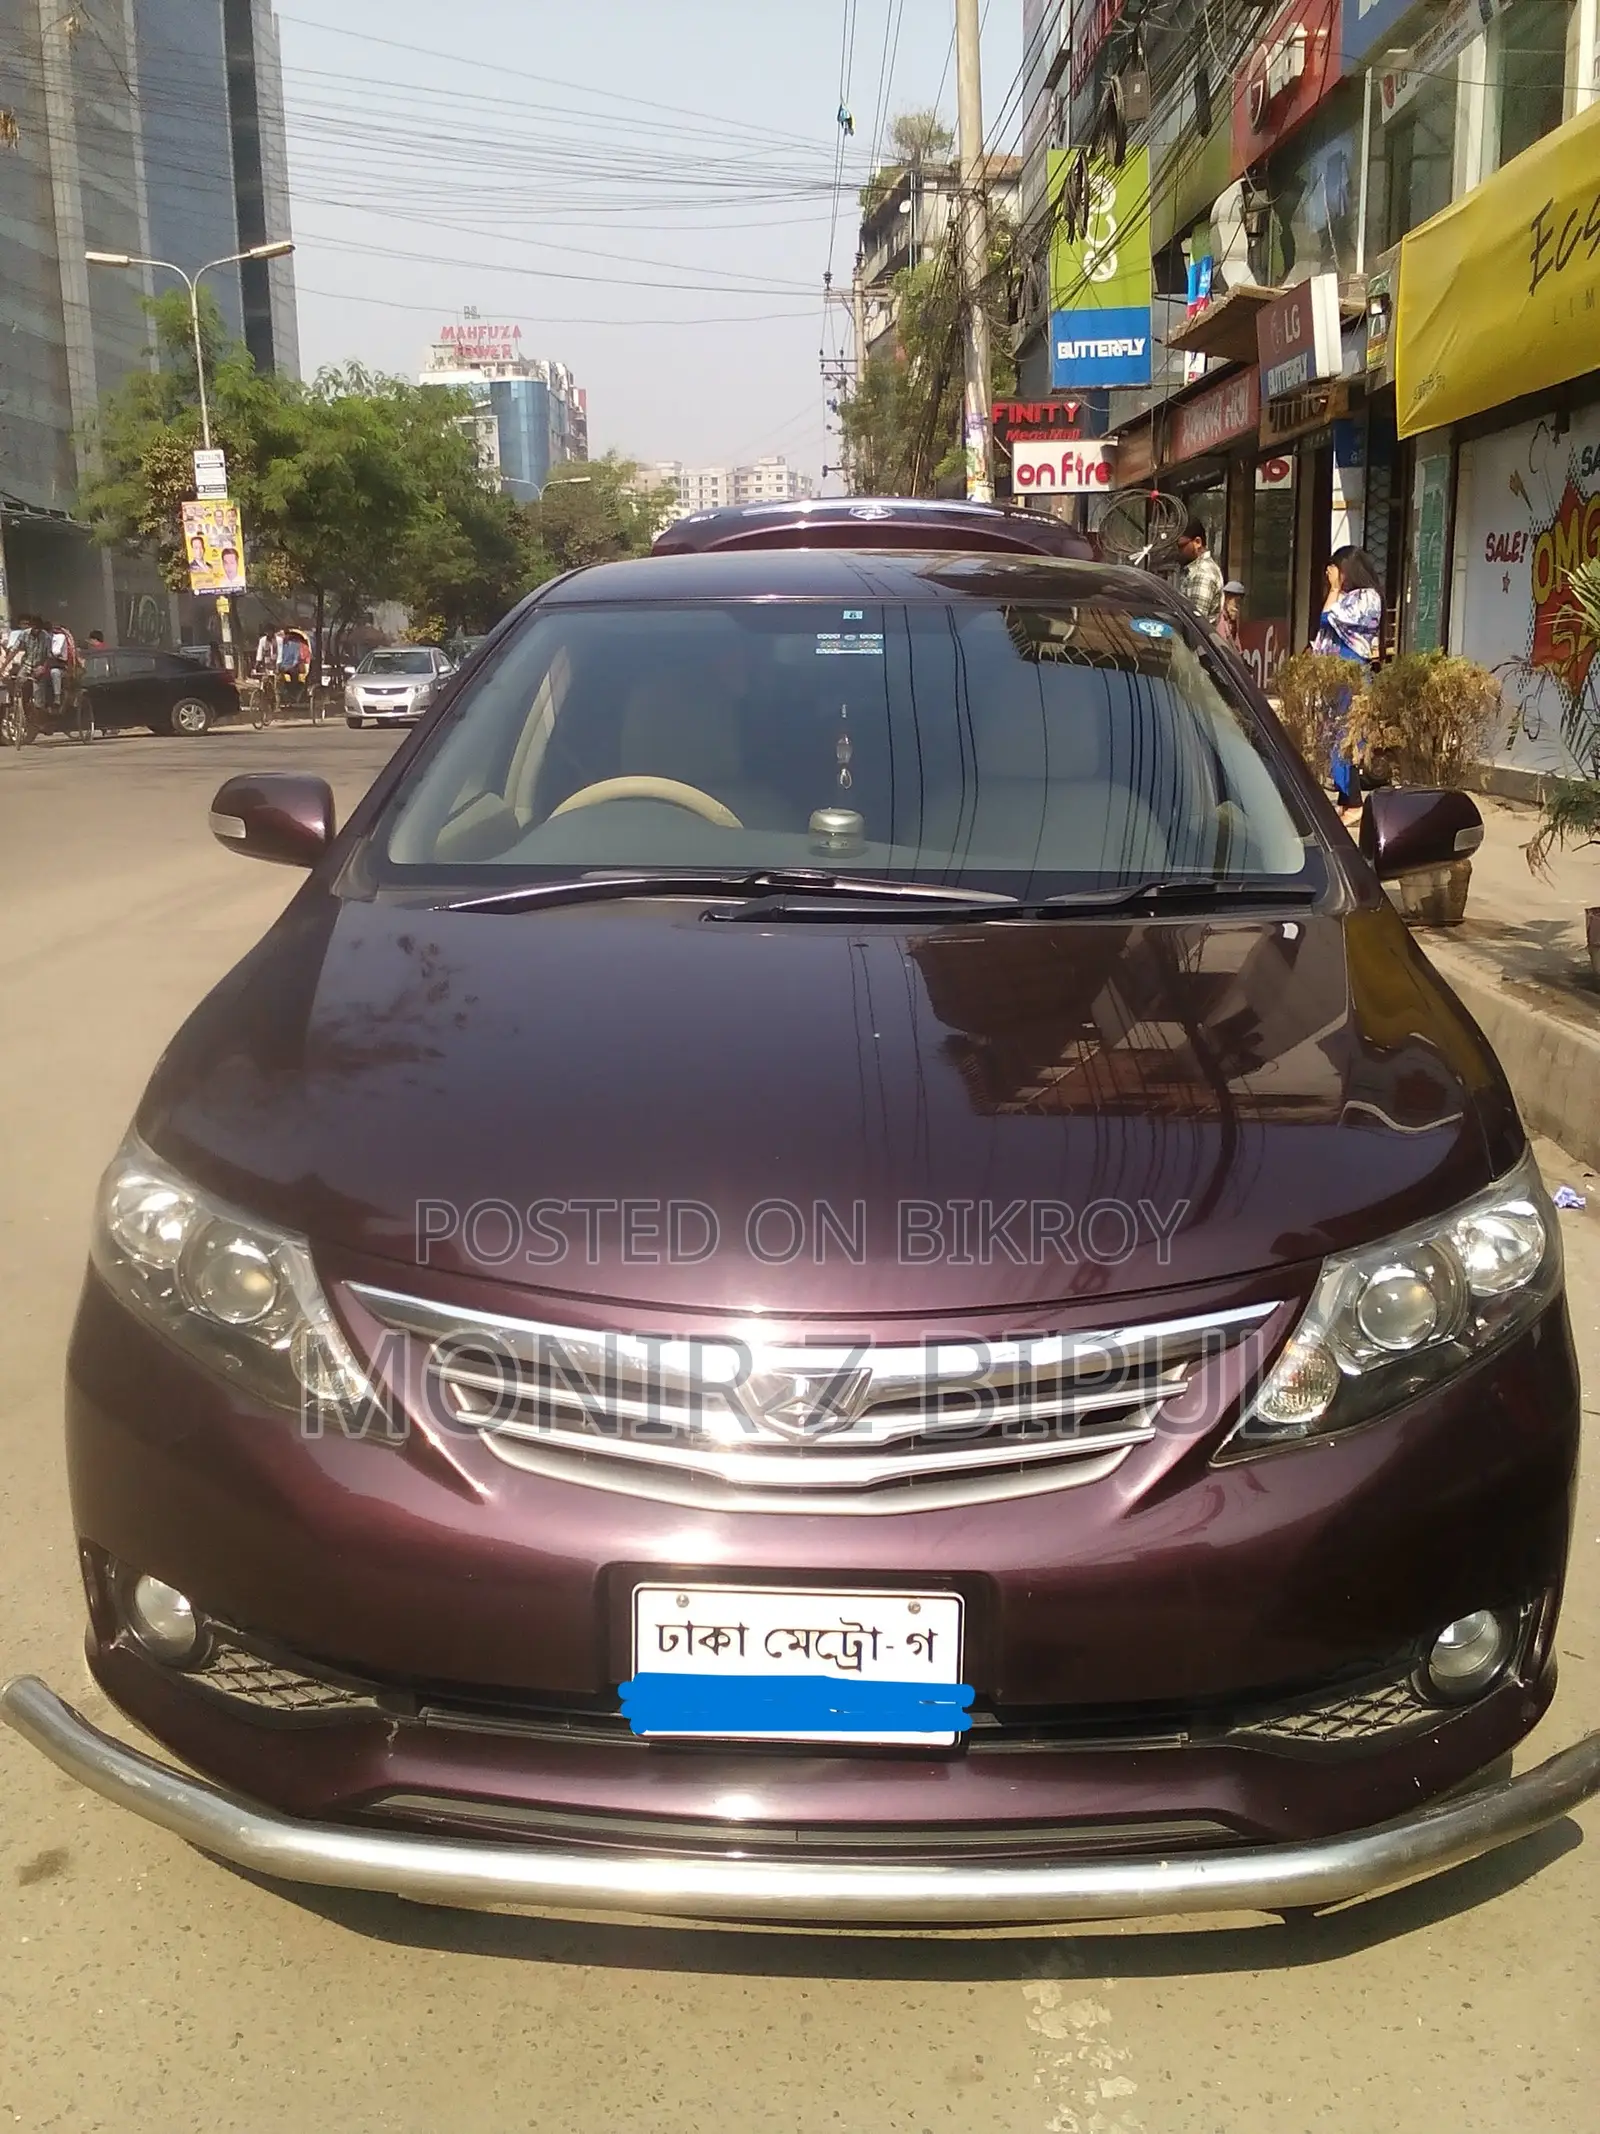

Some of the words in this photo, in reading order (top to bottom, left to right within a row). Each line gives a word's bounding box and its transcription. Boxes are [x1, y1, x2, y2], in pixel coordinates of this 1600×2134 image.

[440, 325, 522, 340] MAHFUZA
[1284, 304, 1300, 344] LG
[1057, 338, 1146, 360] BUTTERFLY
[1485, 528, 1531, 567] SALE!
[655, 1620, 750, 1656] ঢাকা
